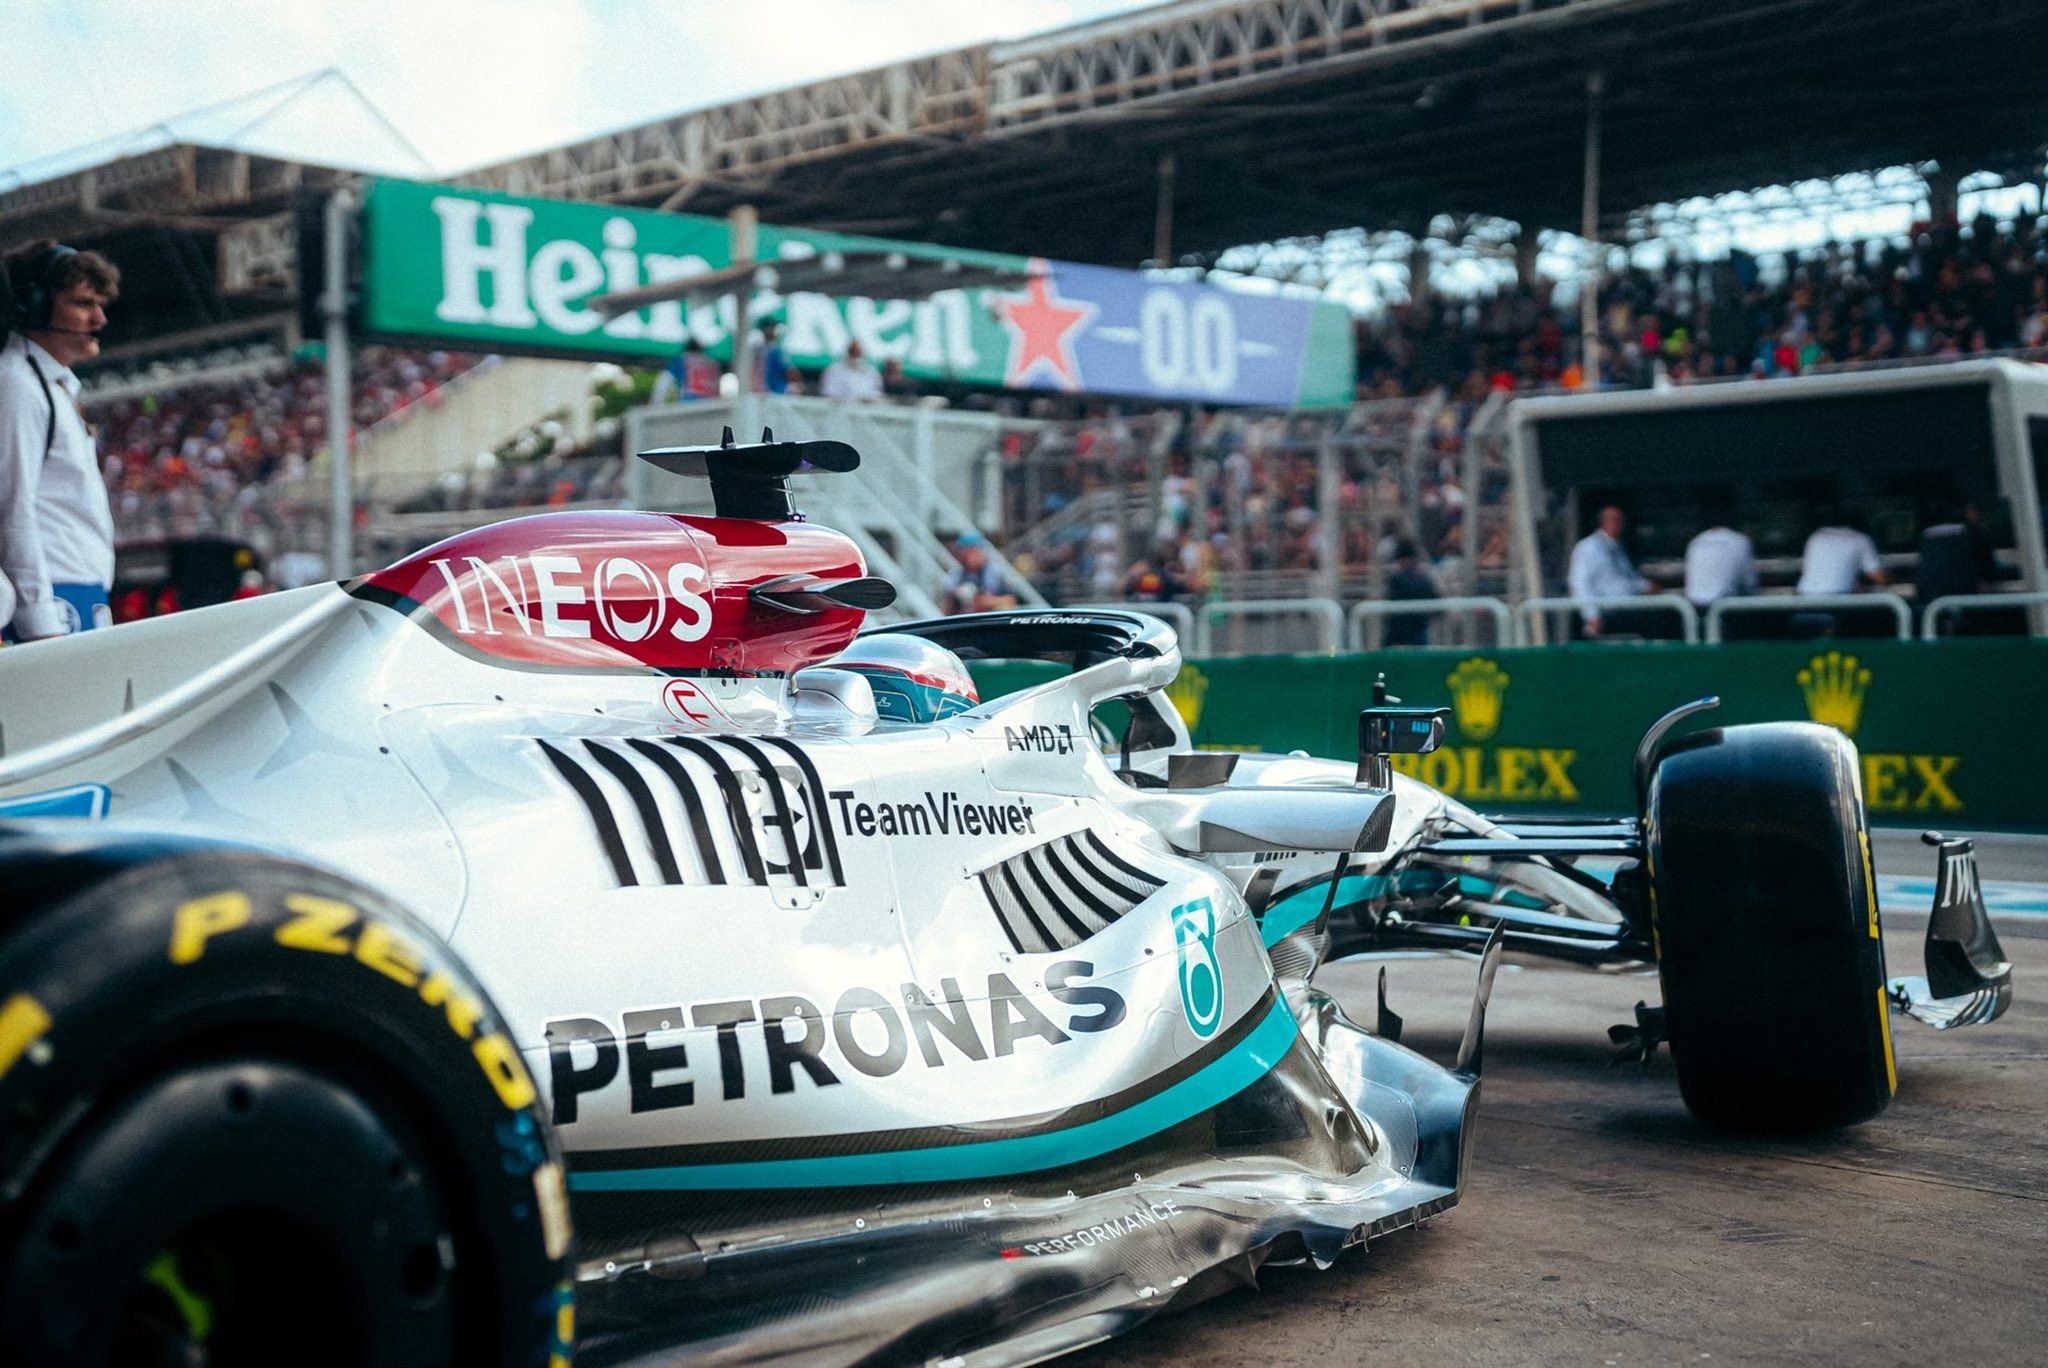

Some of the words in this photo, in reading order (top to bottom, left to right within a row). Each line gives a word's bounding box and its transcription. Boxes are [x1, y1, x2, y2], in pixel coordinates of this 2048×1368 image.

[429, 556, 713, 643] INEOS
[1009, 616, 1092, 625] PETRONAS
[1004, 725, 1056, 752] AMD
[829, 791, 1037, 837] TeamViewer
[545, 960, 1128, 1127] PETRONAS
[1024, 1198, 1184, 1257] PERFORMANCE
